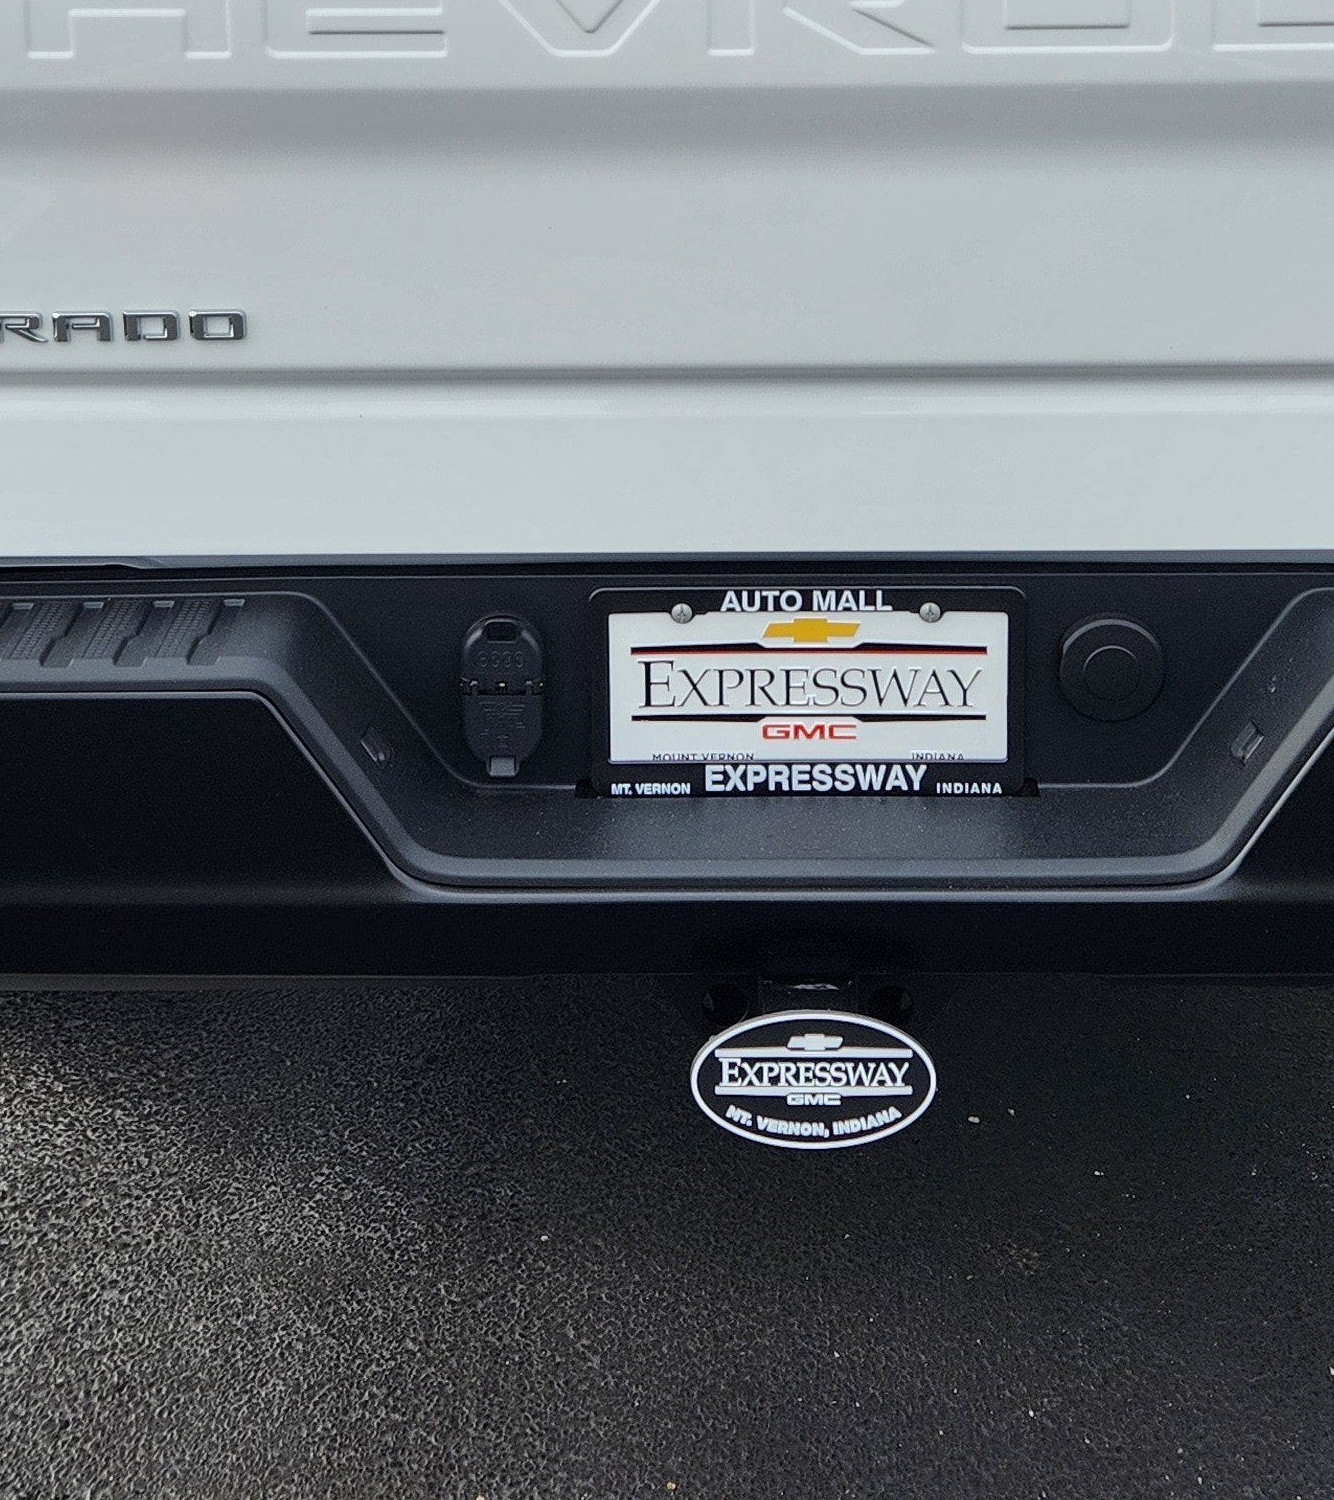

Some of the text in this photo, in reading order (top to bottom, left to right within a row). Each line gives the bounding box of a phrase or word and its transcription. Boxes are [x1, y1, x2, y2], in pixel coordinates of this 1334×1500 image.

[720, 589, 893, 612] AUTO MALL
[637, 660, 982, 709] EXPRESSWAY
[761, 723, 857, 741] GMC
[610, 764, 1003, 795] MT. VERNON EXPRESSWAY INDIANA
[718, 1057, 910, 1088] EXPRESSWAY
[786, 1093, 841, 1106] GMC
[725, 1105, 903, 1138] MT. VERNON, INDIANA
